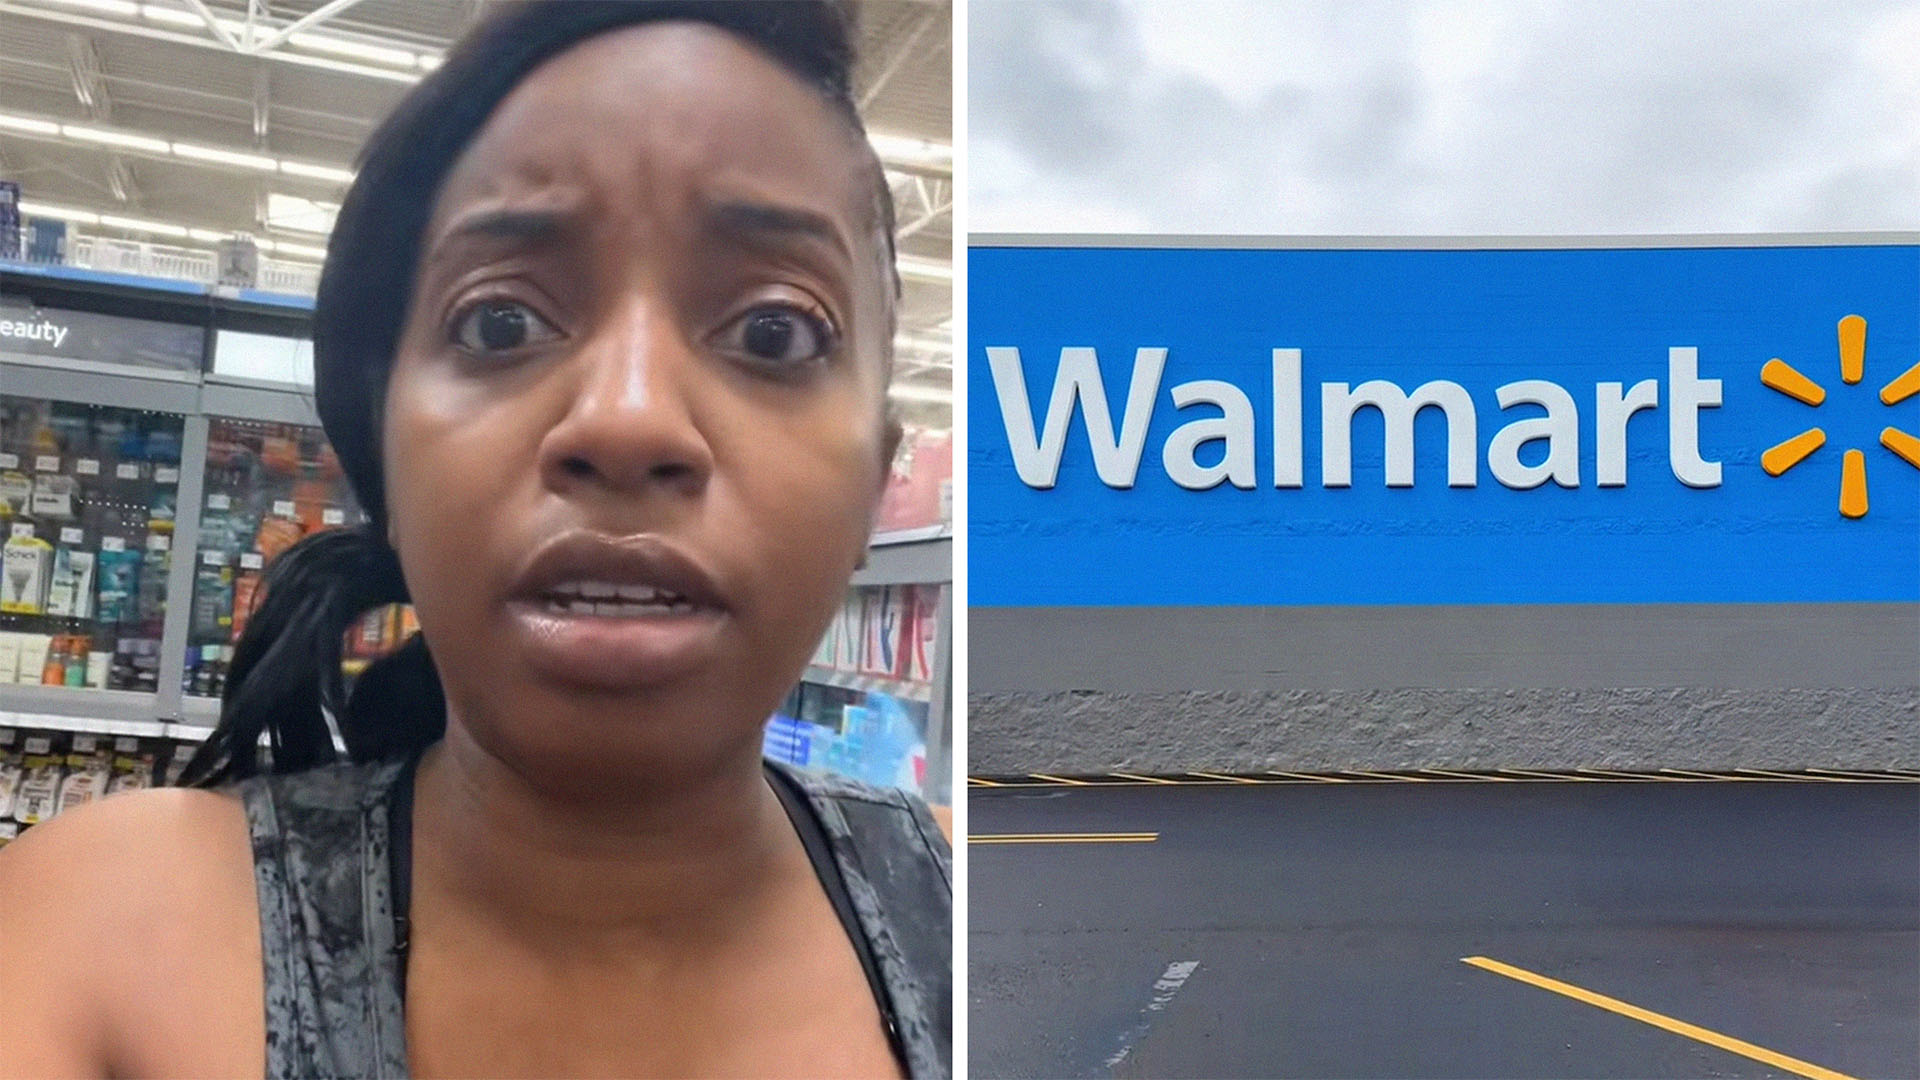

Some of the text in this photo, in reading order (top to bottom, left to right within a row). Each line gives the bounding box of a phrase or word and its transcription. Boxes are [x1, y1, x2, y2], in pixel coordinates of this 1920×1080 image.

[0, 320, 68, 348] eauty
[986, 346, 1723, 488] Walmart
[5, 549, 37, 560] Schick
